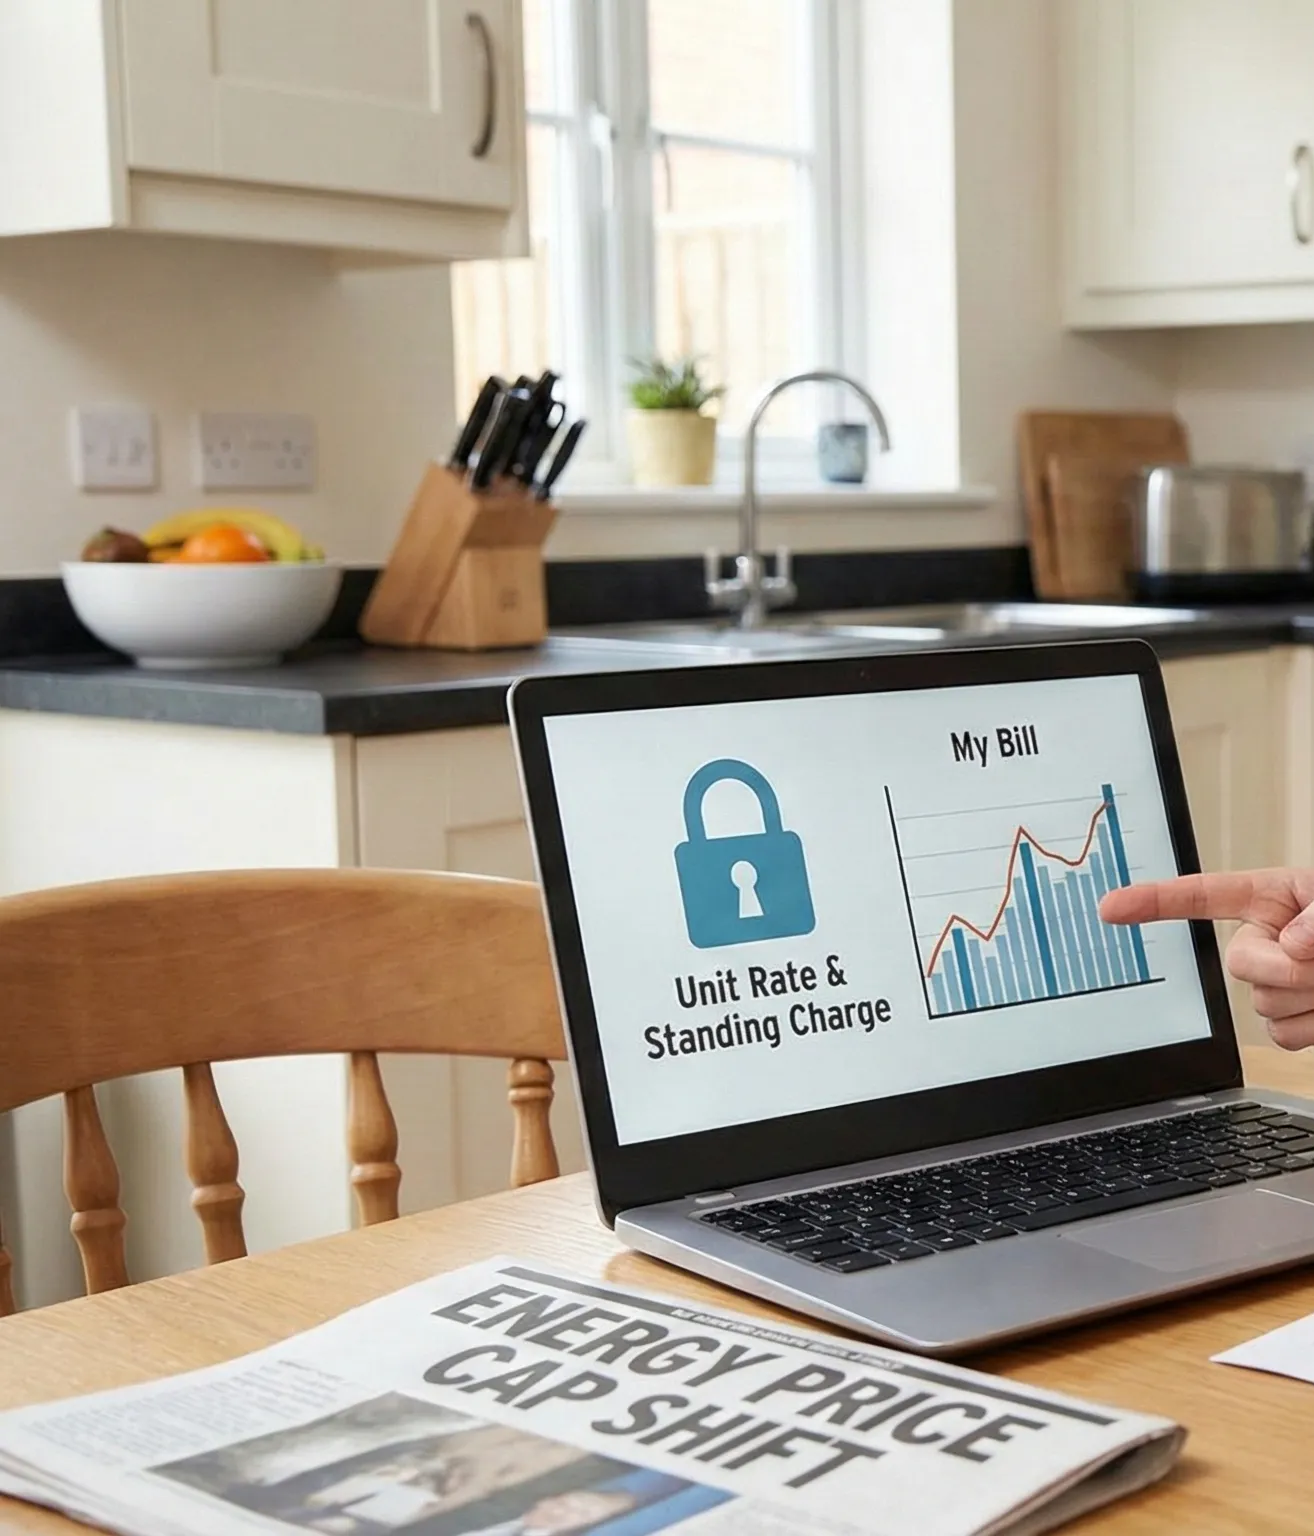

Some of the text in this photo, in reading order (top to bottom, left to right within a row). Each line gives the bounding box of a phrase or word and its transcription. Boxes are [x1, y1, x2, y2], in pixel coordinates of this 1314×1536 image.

[950, 724, 1039, 768] My Bill
[674, 954, 848, 1009] Unit Rate &
[644, 998, 892, 1060] Standing Charge
[431, 1283, 783, 1387] ENERGY
[743, 1362, 1048, 1464] PRICE
[422, 1344, 888, 1489] CAP SHIFT
